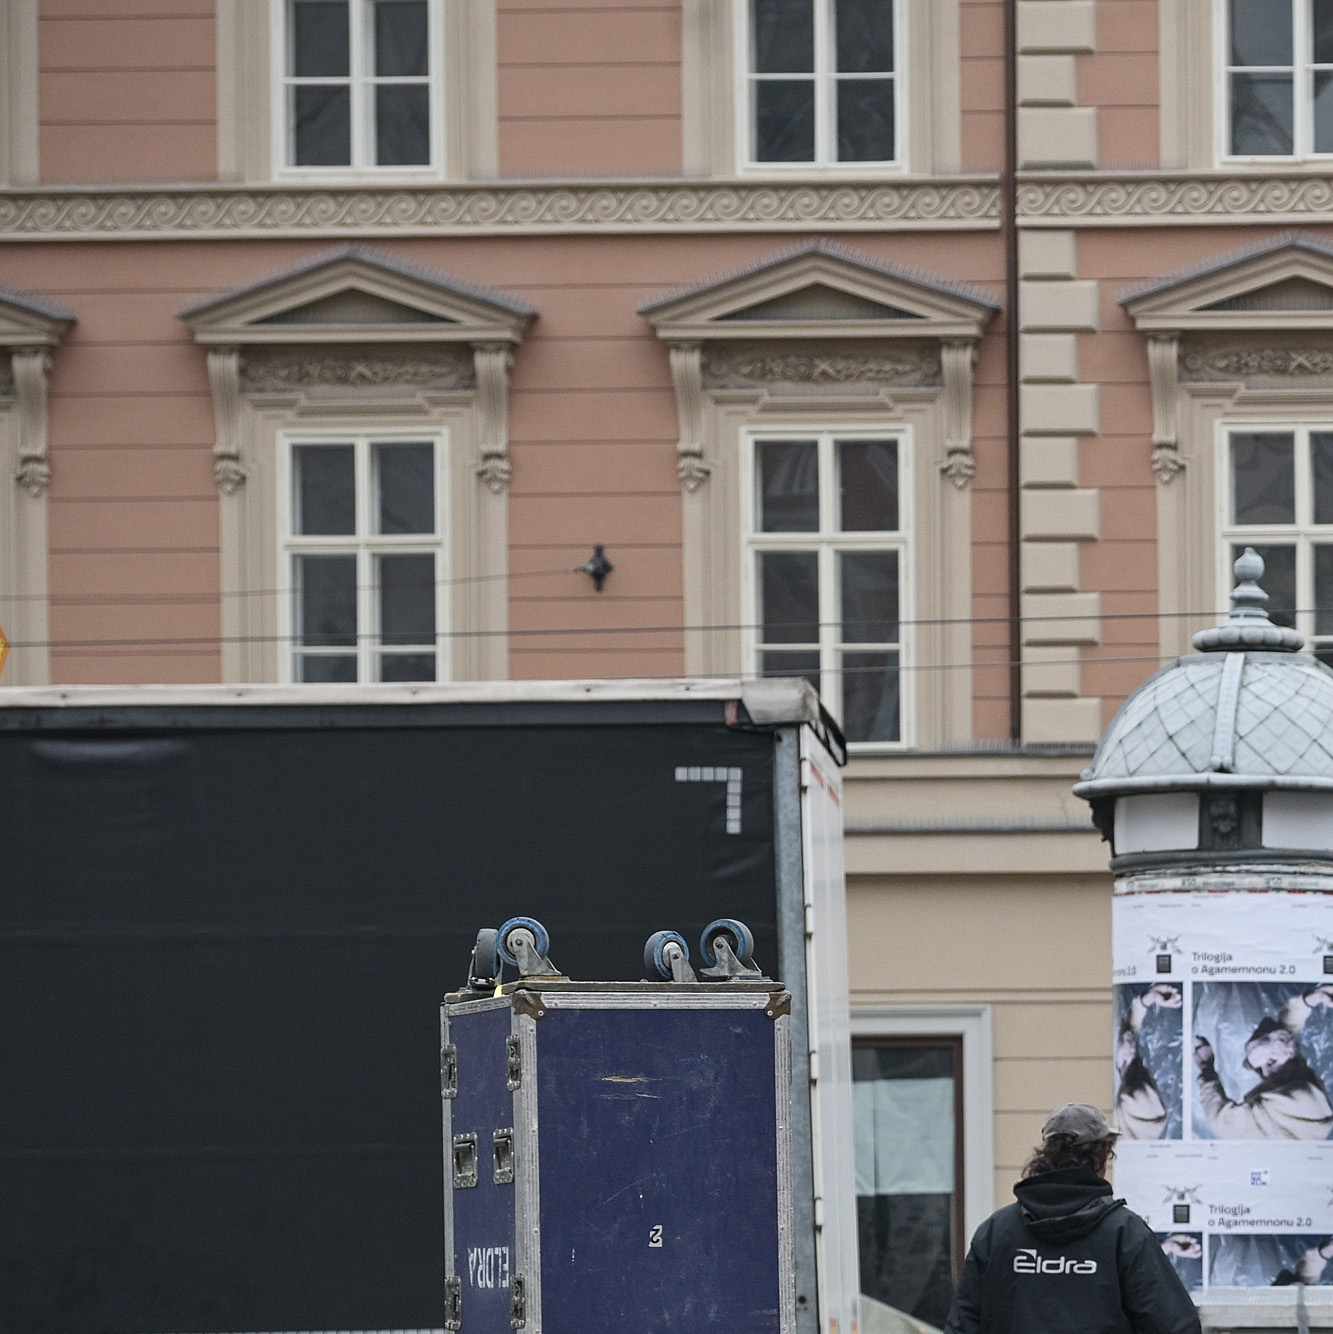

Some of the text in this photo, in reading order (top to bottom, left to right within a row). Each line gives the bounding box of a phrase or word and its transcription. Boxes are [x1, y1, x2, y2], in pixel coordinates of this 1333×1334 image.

[1191, 951, 1233, 964] Trilogija
[1191, 964, 1296, 977] o Agamemnonu 2.0
[1209, 1204, 1251, 1216] Trilogija
[1217, 1216, 1294, 1229] Agamemnonu
[1296, 1216, 1312, 1227] 2.0
[467, 1246, 510, 1289] ELDRA
[1013, 1248, 1098, 1275] Eldra
